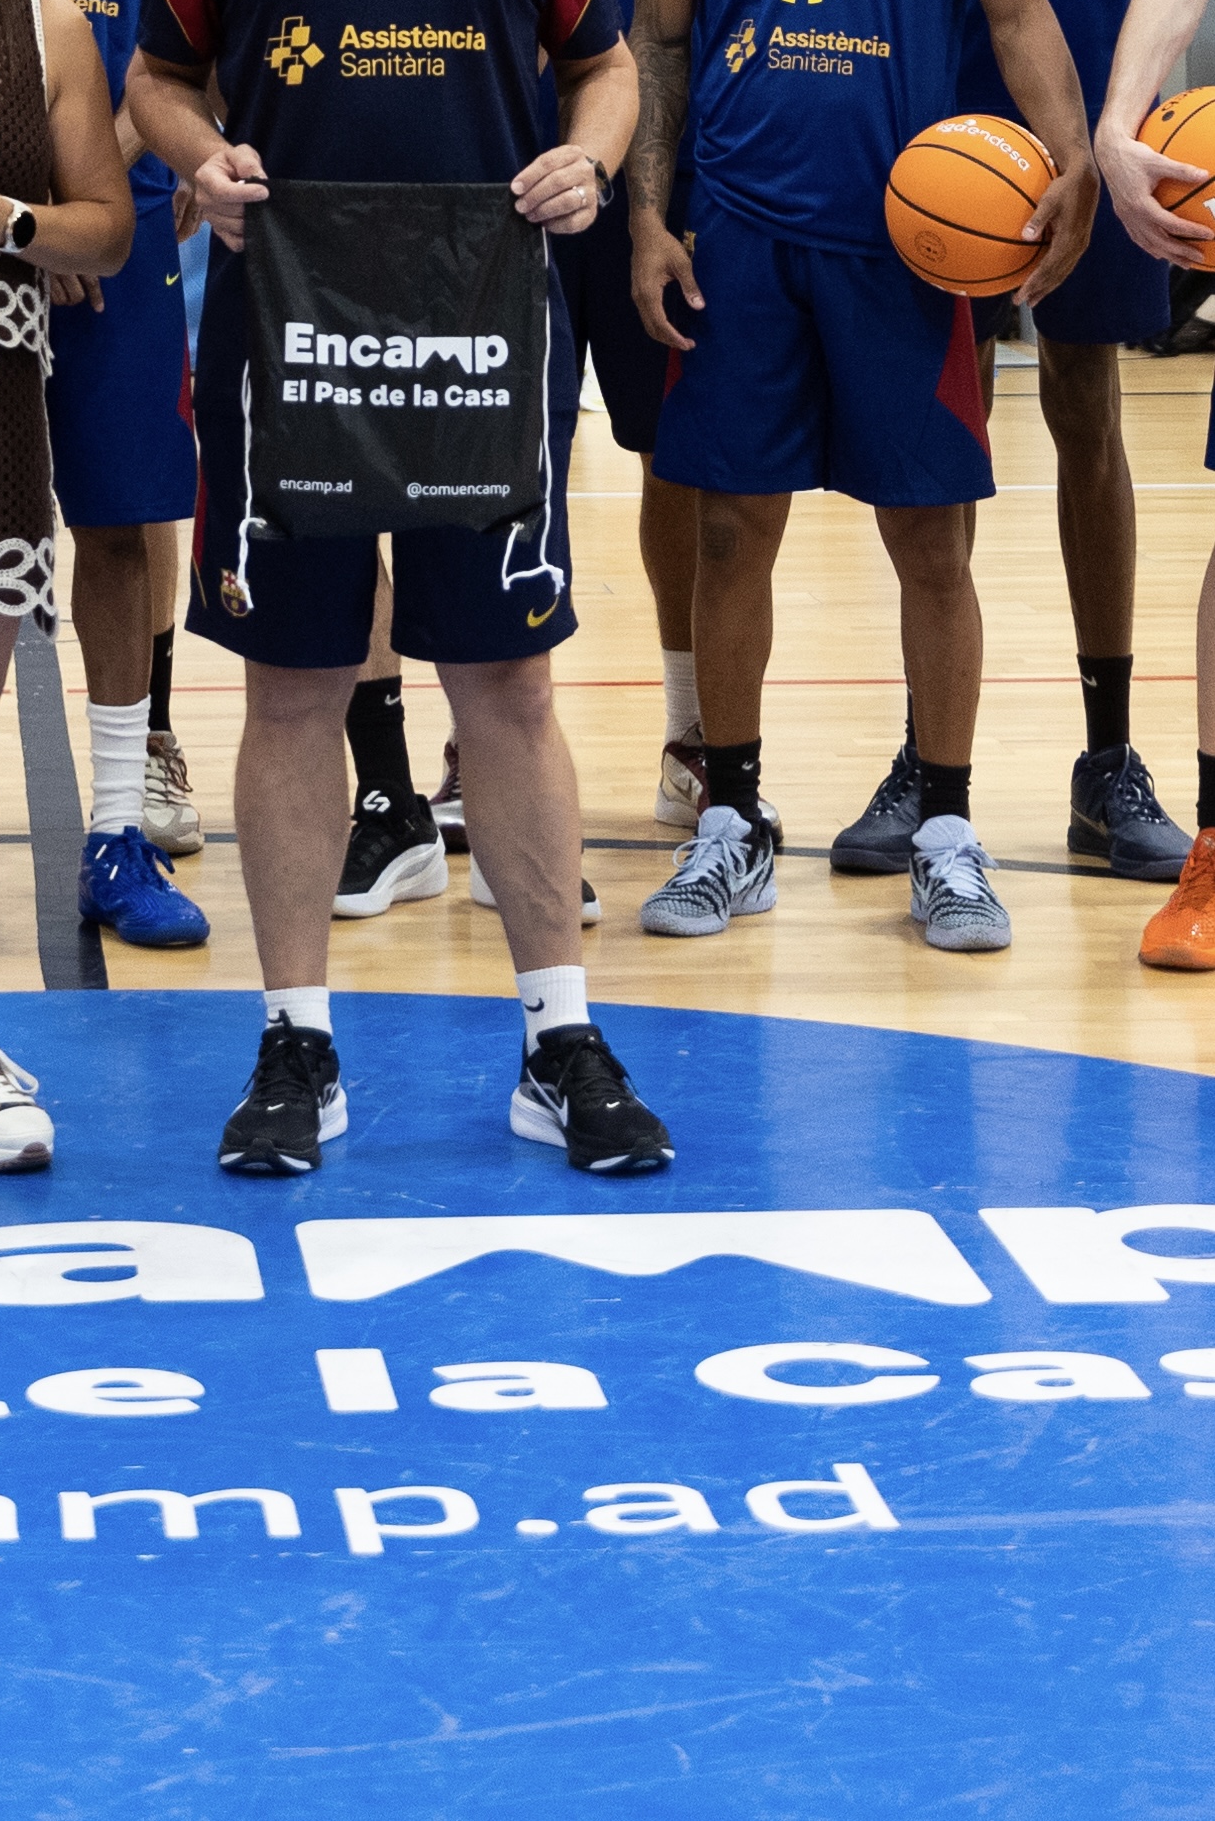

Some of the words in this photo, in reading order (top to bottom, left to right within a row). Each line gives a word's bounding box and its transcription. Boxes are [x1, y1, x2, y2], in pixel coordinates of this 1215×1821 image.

[339, 24, 486, 50] Assistència
[769, 26, 891, 58] Assistència
[340, 52, 445, 77] Sanitària
[767, 49, 854, 75] Sanitària
[284, 321, 509, 374] Encamp
[282, 379, 308, 402] El
[314, 380, 363, 406] Pas
[368, 384, 405, 406] de
[413, 384, 439, 407] la
[444, 384, 510, 407] Casa
[279, 478, 353, 495] encamp.ad
[406, 481, 511, 499] @comuencamp
[315, 1348, 608, 1412] la
